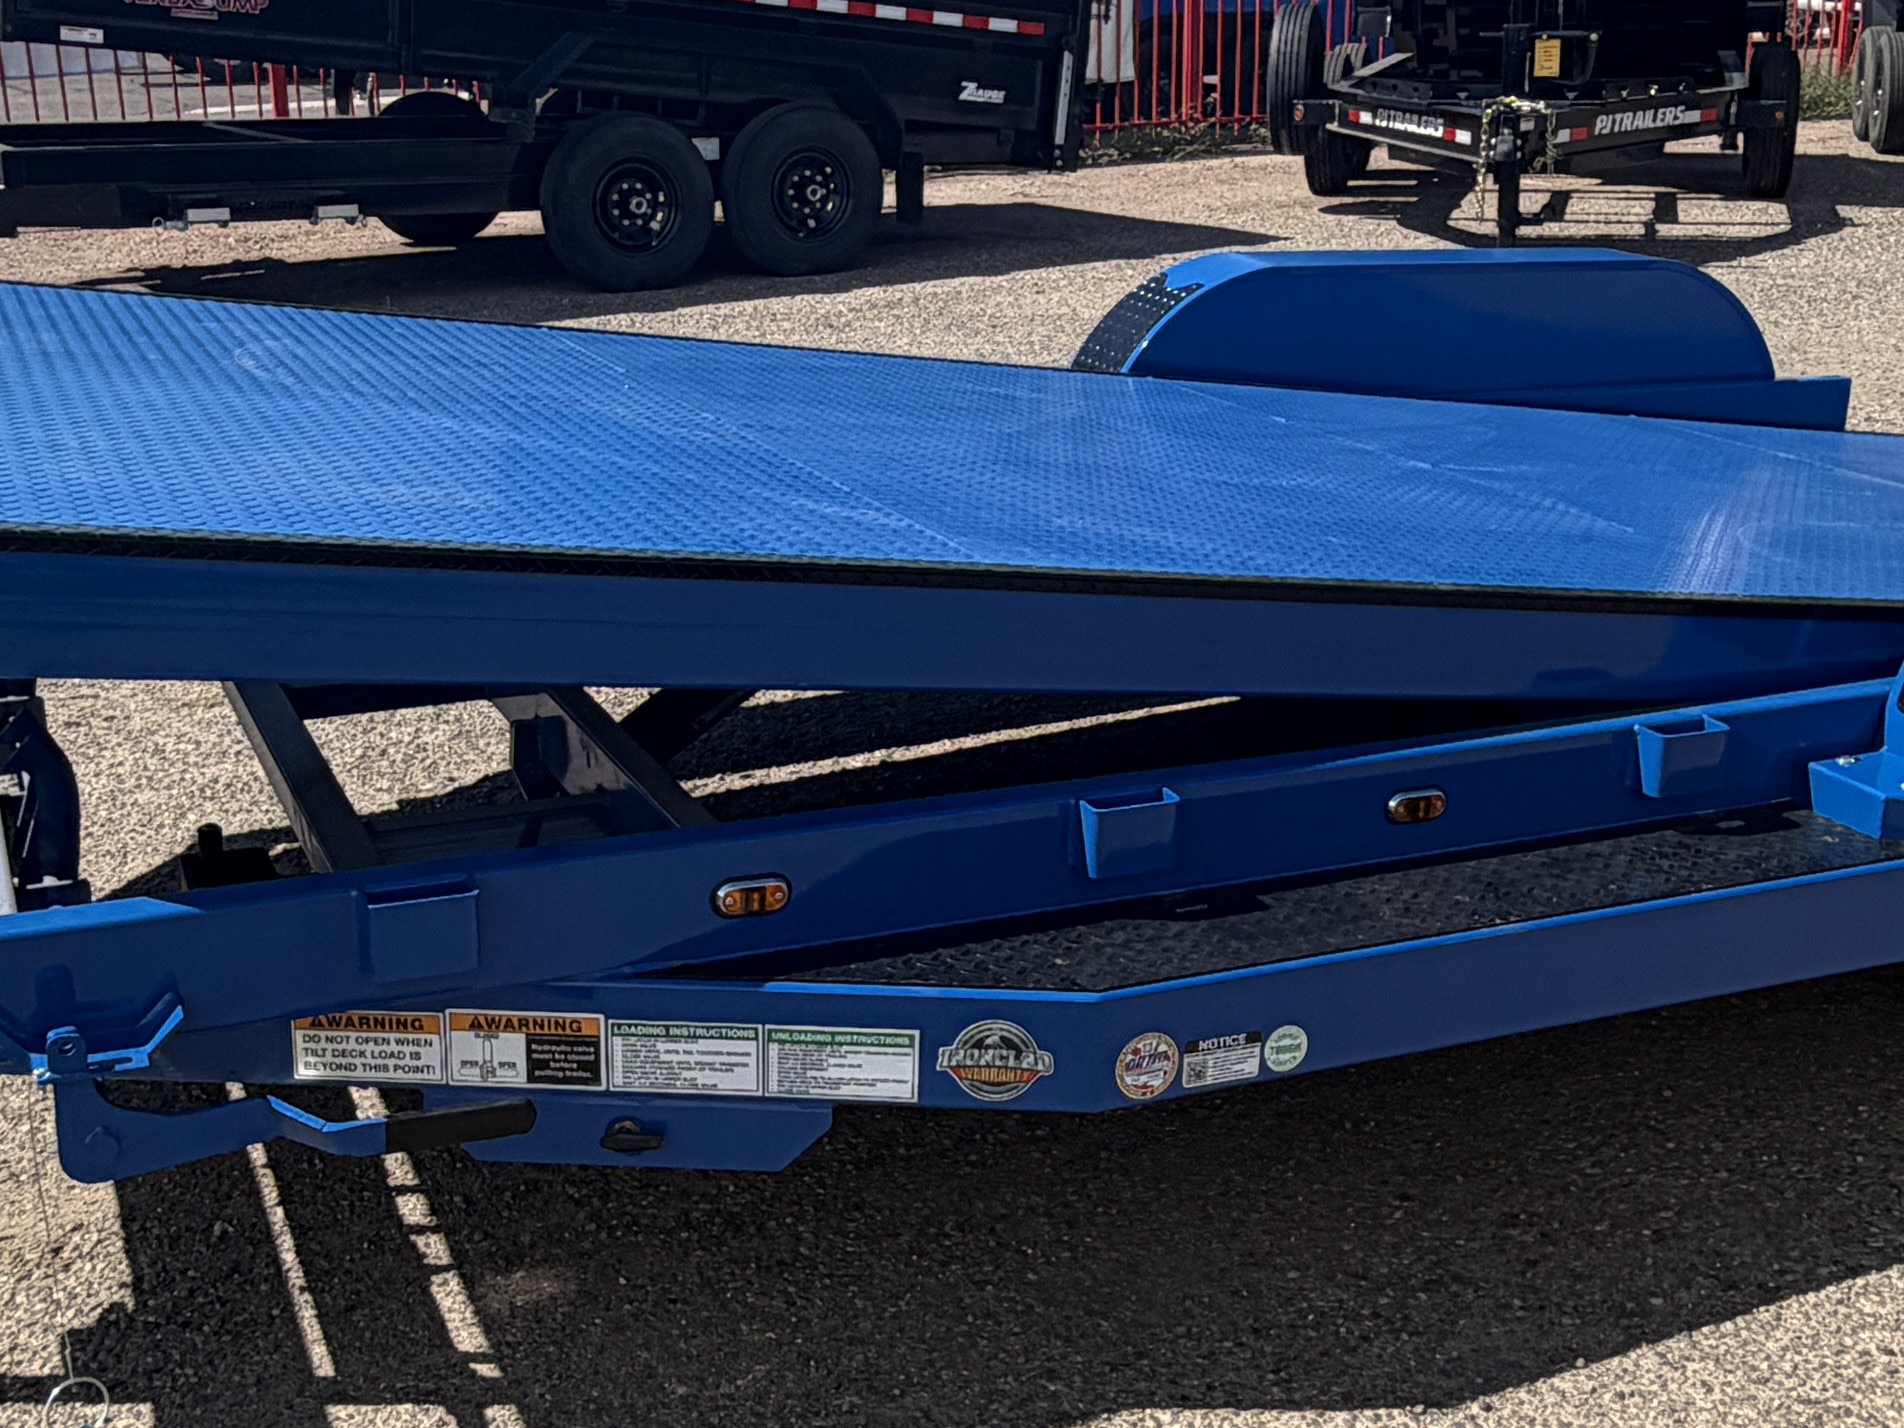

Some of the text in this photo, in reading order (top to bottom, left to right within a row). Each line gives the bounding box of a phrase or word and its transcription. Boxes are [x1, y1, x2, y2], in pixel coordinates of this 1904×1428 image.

[321, 1014, 425, 1032] WARNING
[484, 1015, 583, 1033] WARNING
[613, 1025, 756, 1038] LOADING INSTRUCTIONS
[771, 1031, 911, 1046] UNLOADING INSTRUCTIONS
[302, 1033, 434, 1048] DO NOT OPEN WHEN
[1198, 1033, 1248, 1051] NOTICE
[302, 1047, 422, 1061] TILT DECK LOAD IS
[942, 1048, 1051, 1072] IRONCLAD
[303, 1061, 358, 1073] BEYOND
[361, 1062, 390, 1073] THIS
